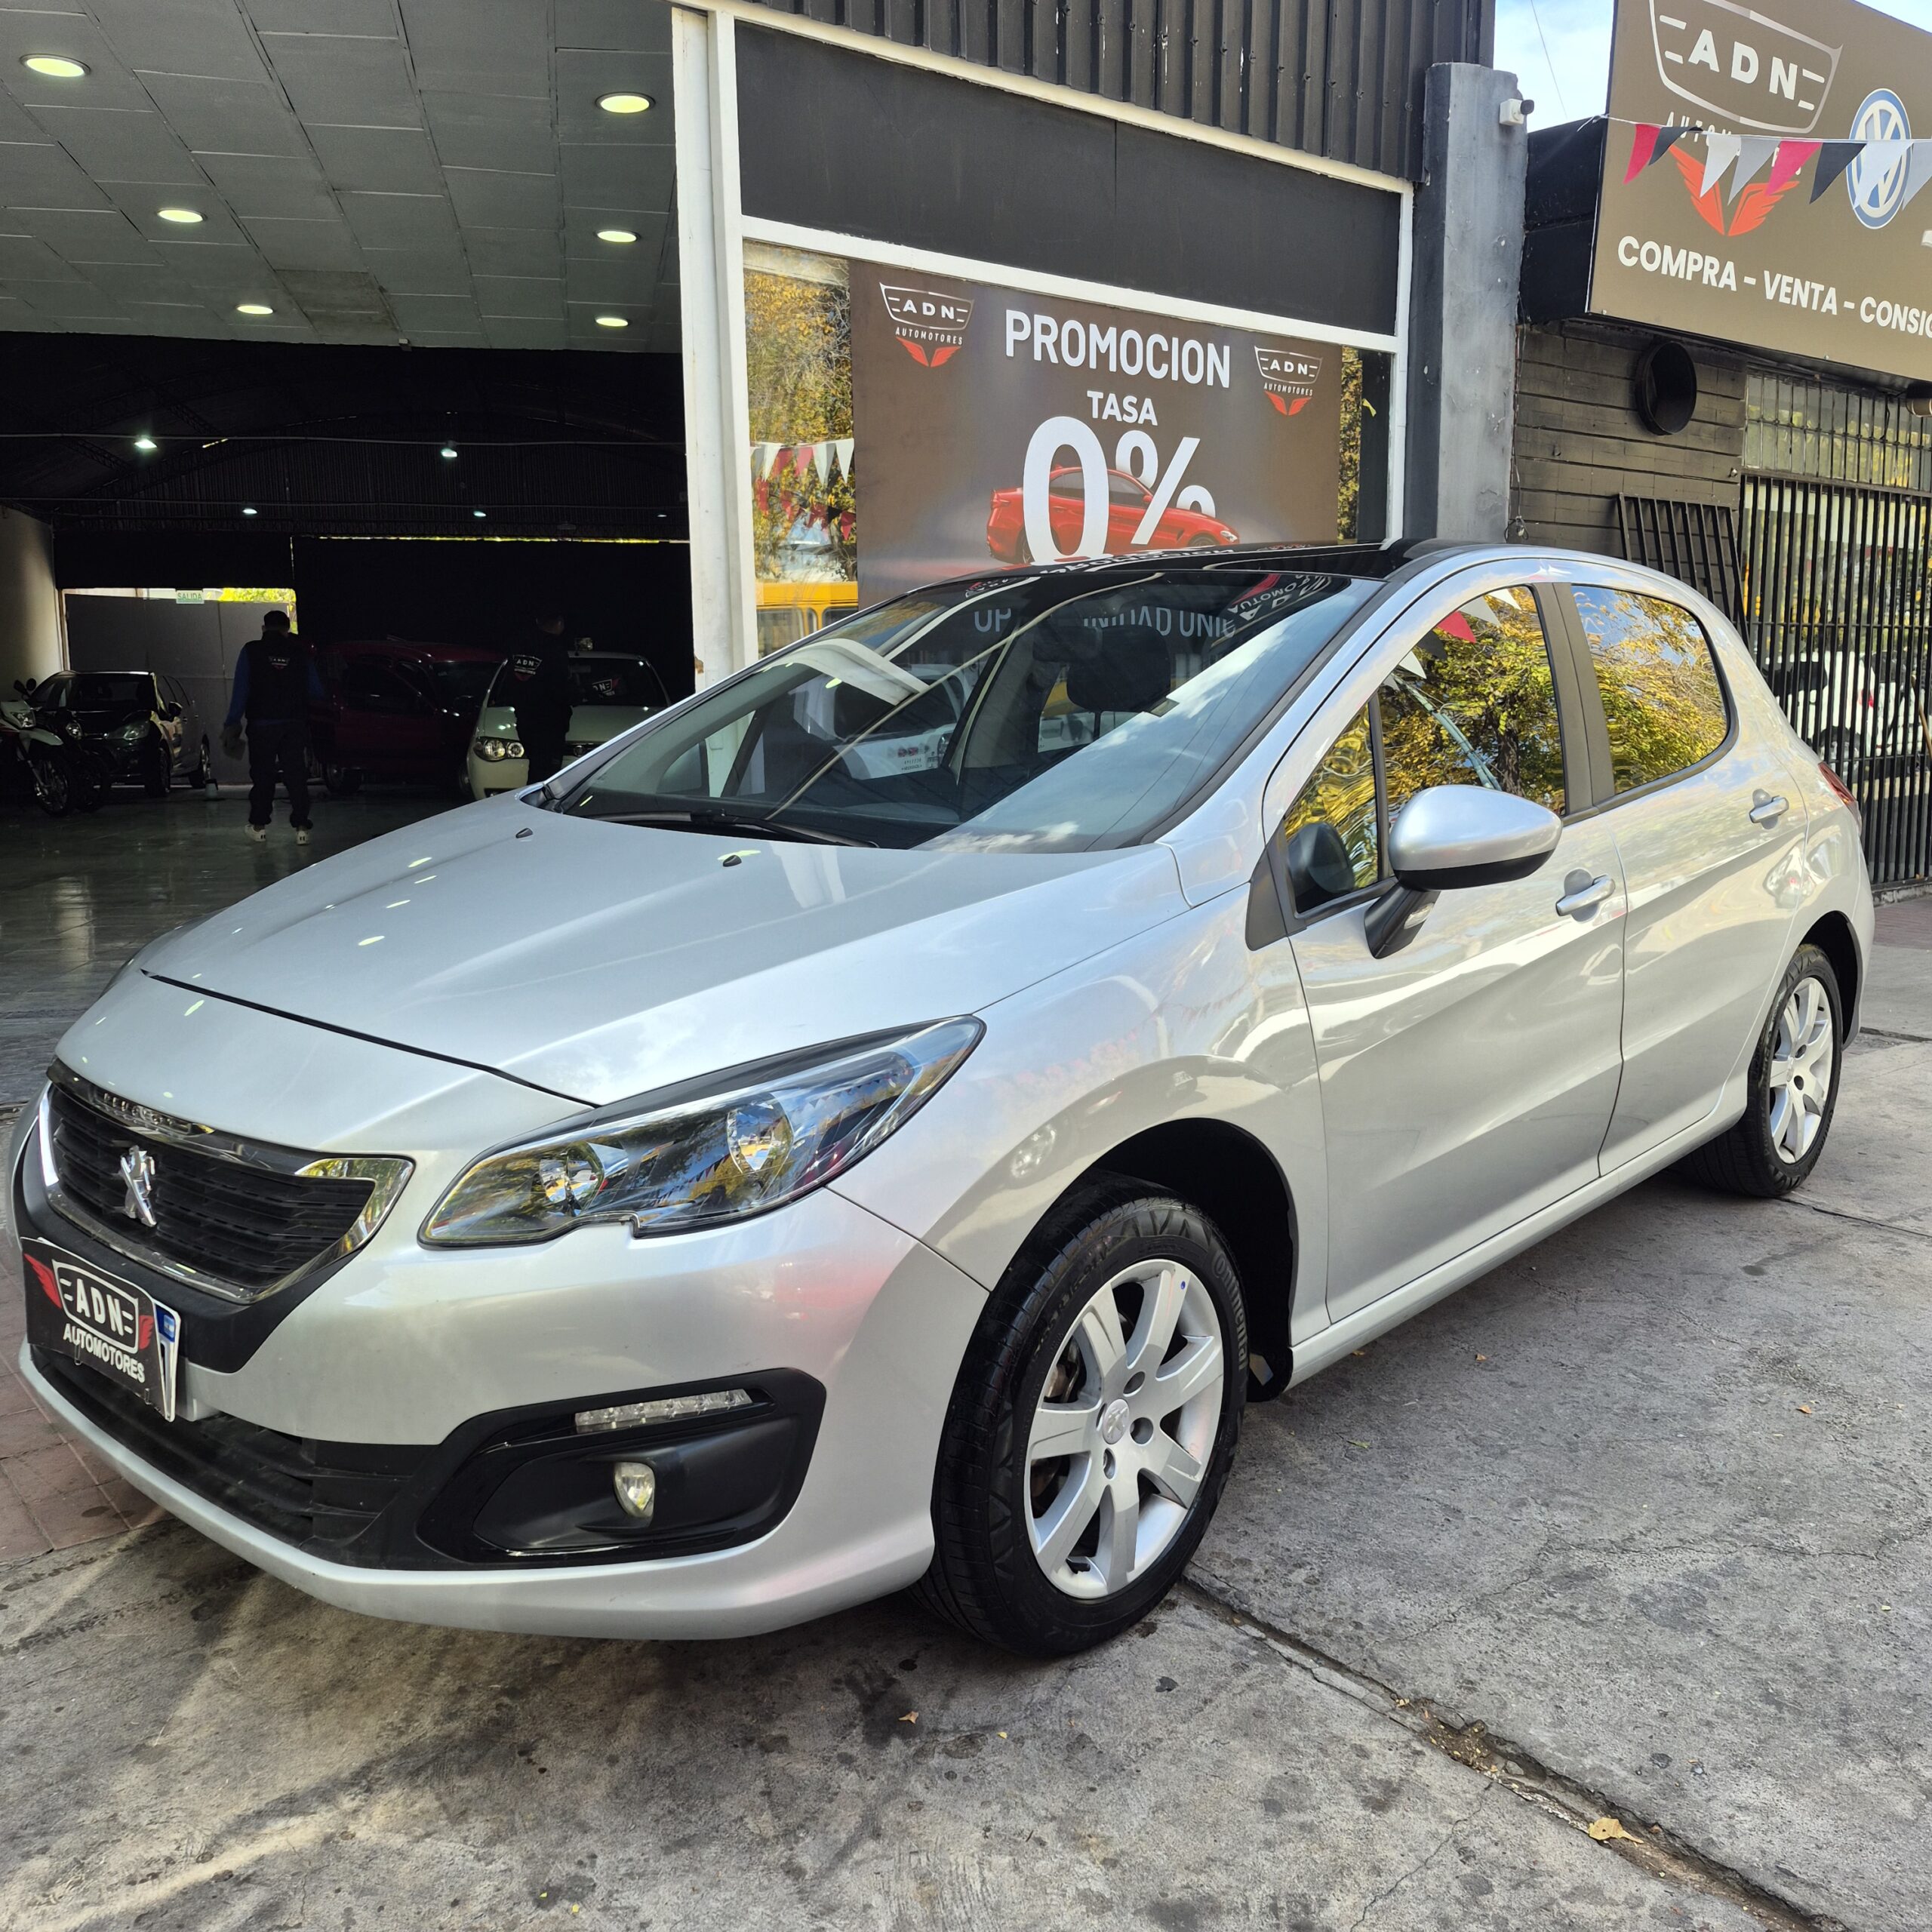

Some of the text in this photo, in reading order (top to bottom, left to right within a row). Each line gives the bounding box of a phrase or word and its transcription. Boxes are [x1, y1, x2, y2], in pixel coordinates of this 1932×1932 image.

[1687, 29, 1798, 100] ADN
[1618, 235, 1737, 291] COMPRA
[1764, 270, 1837, 315] VENTA
[903, 299, 955, 320] ADN
[895, 327, 963, 346] AUTOMOTORES
[1005, 309, 1230, 389] PROMOCION
[1270, 358, 1309, 375] ADN
[1263, 382, 1313, 396] AUTOMOTORES
[1087, 390, 1158, 426] TASA
[1023, 416, 1216, 565] 0%
[177, 592, 202, 601] SALIDA
[516, 658, 534, 666] ADN
[76, 1278, 124, 1337] ADN
[63, 1323, 145, 1383] AUTOMOTORES
